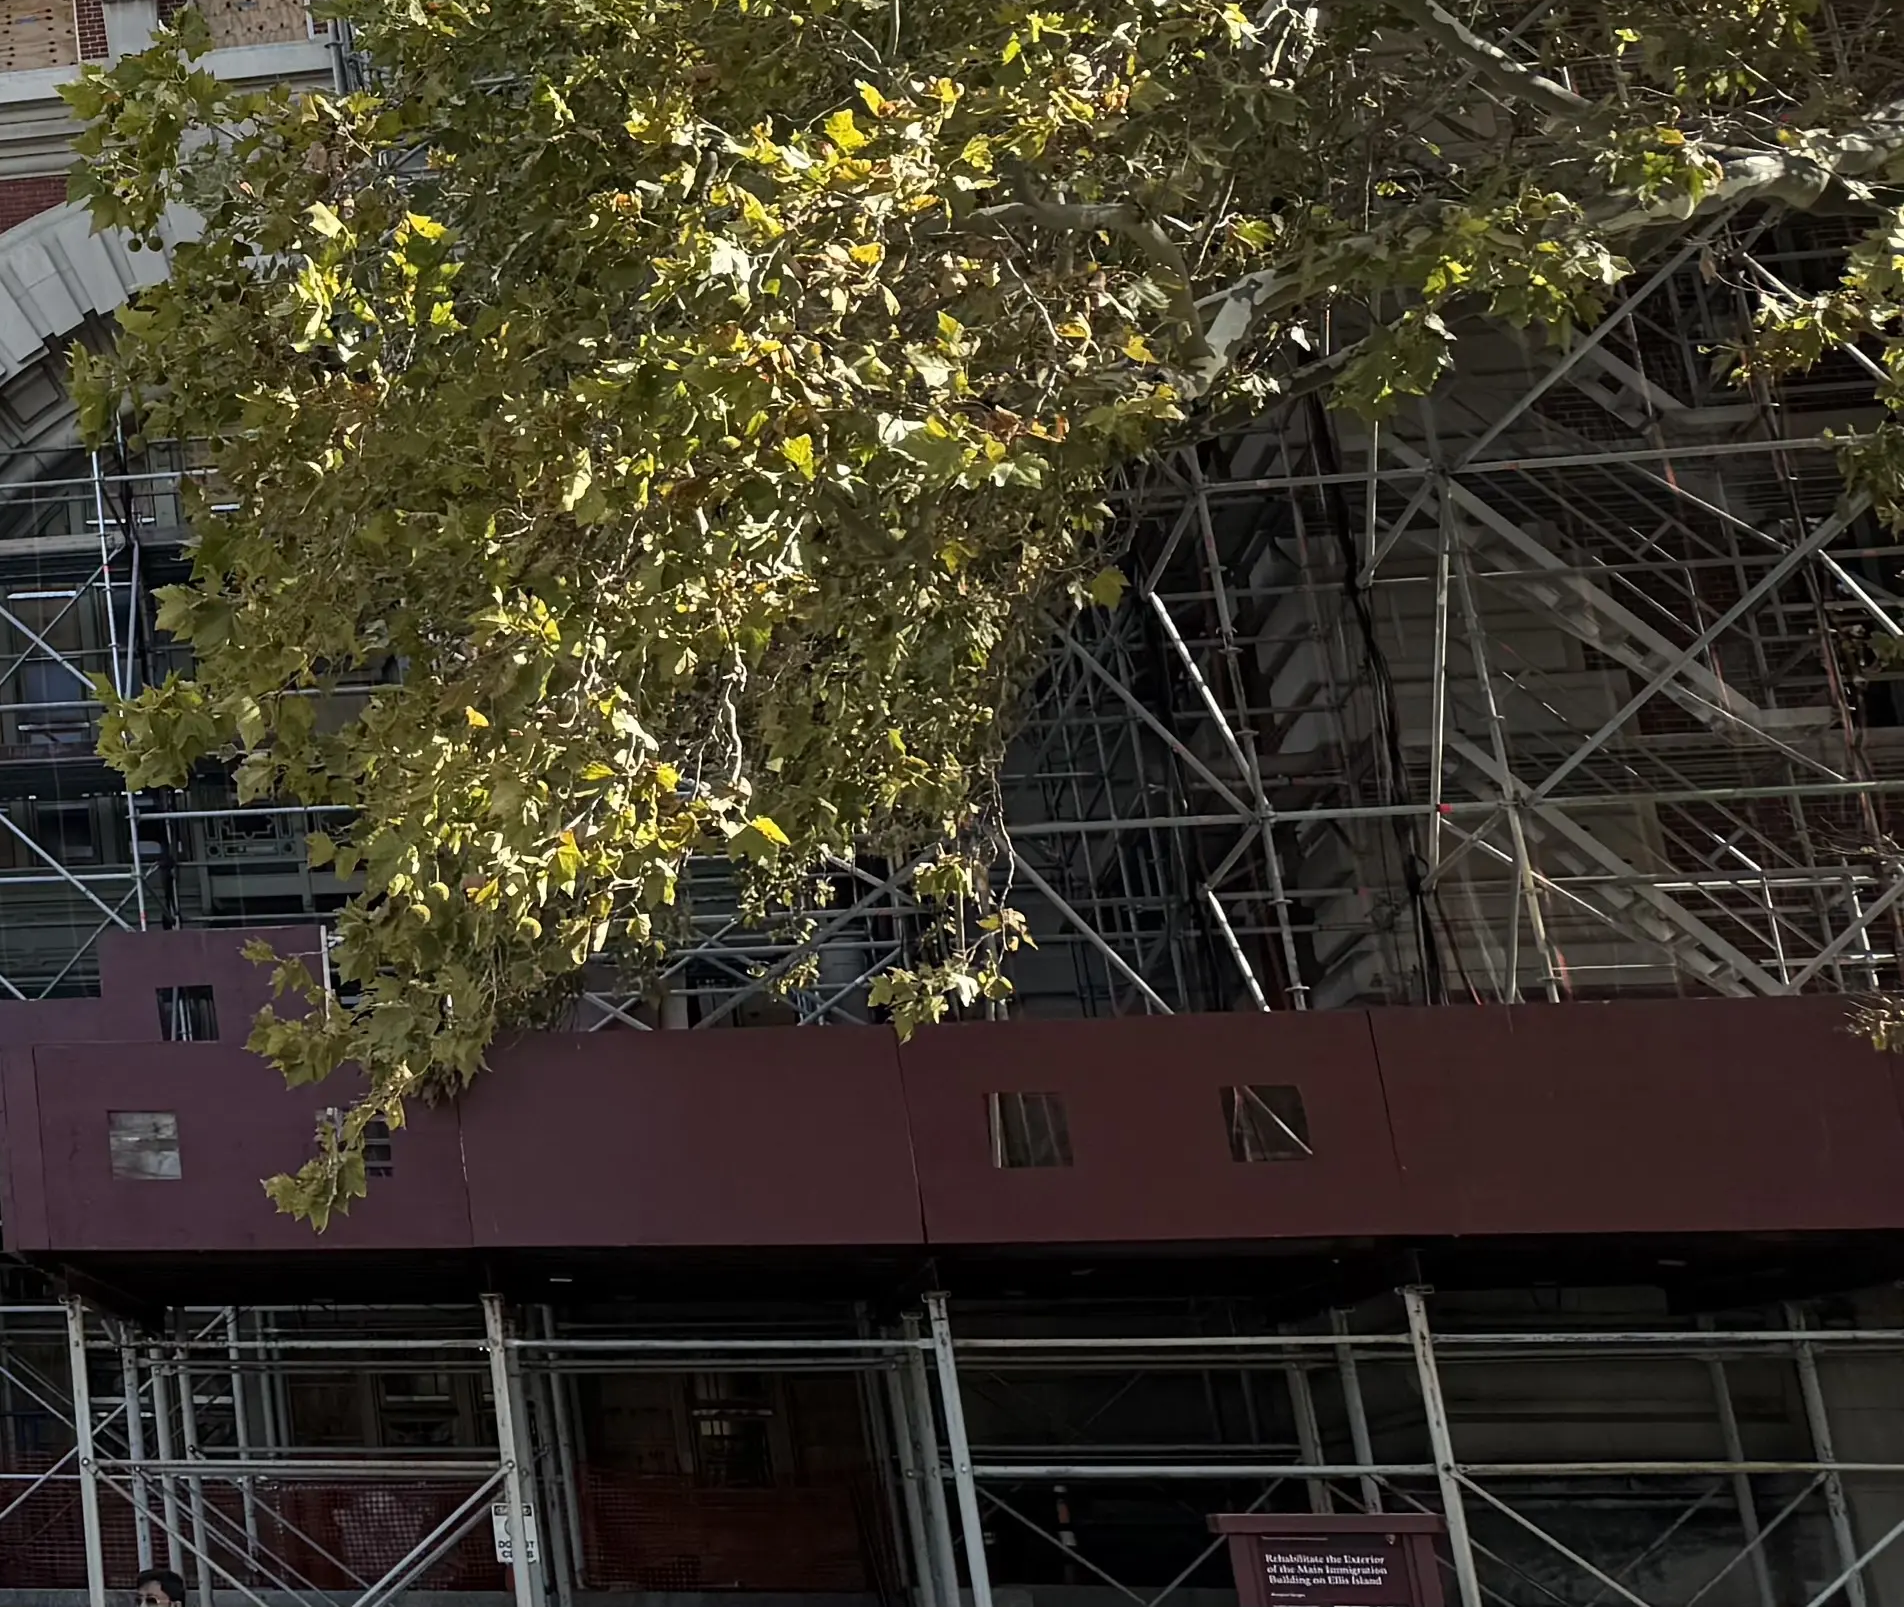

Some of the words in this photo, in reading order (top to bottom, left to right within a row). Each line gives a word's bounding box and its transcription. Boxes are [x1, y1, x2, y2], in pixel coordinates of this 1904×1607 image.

[1265, 1554, 1324, 1564] Rehabilitate
[1326, 1554, 1341, 1564] the
[1343, 1555, 1385, 1564] Exterior
[1267, 1565, 1278, 1574] of
[1279, 1565, 1294, 1574] the
[1297, 1565, 1323, 1574] Main
[1326, 1565, 1388, 1576] Immigration
[1269, 1575, 1312, 1586] Building
[1313, 1577, 1326, 1585] on
[1327, 1575, 1349, 1585] Ellis
[1352, 1575, 1382, 1585] Island
